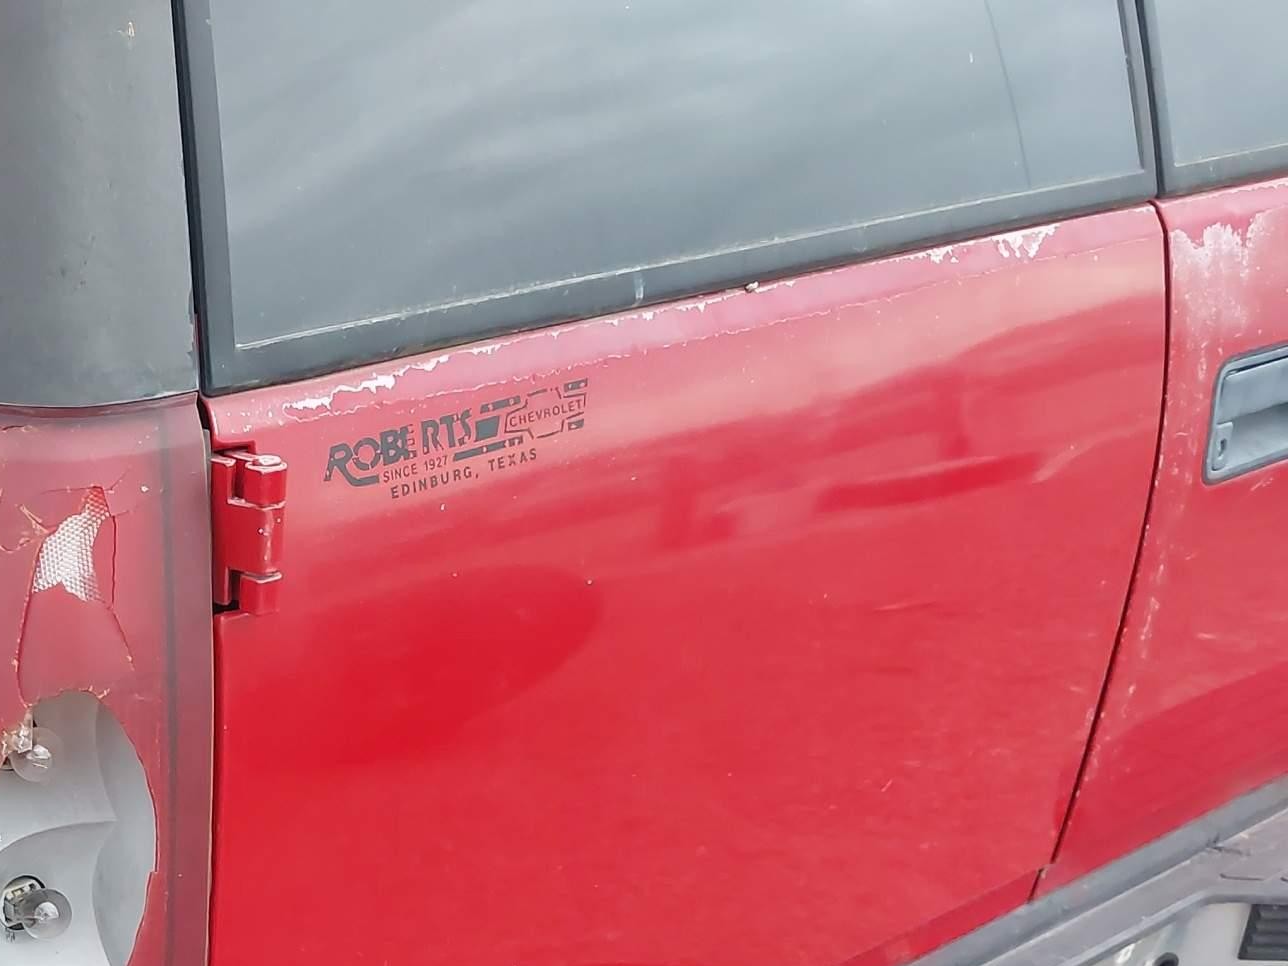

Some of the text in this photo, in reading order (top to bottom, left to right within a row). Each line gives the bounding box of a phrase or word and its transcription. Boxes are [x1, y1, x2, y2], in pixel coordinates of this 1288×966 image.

[509, 399, 583, 428] CHEVROLET
[323, 408, 472, 487] ROBERTS
[383, 455, 449, 484] SINCE 1927
[391, 448, 538, 500] EDINBURG, TEXAS
